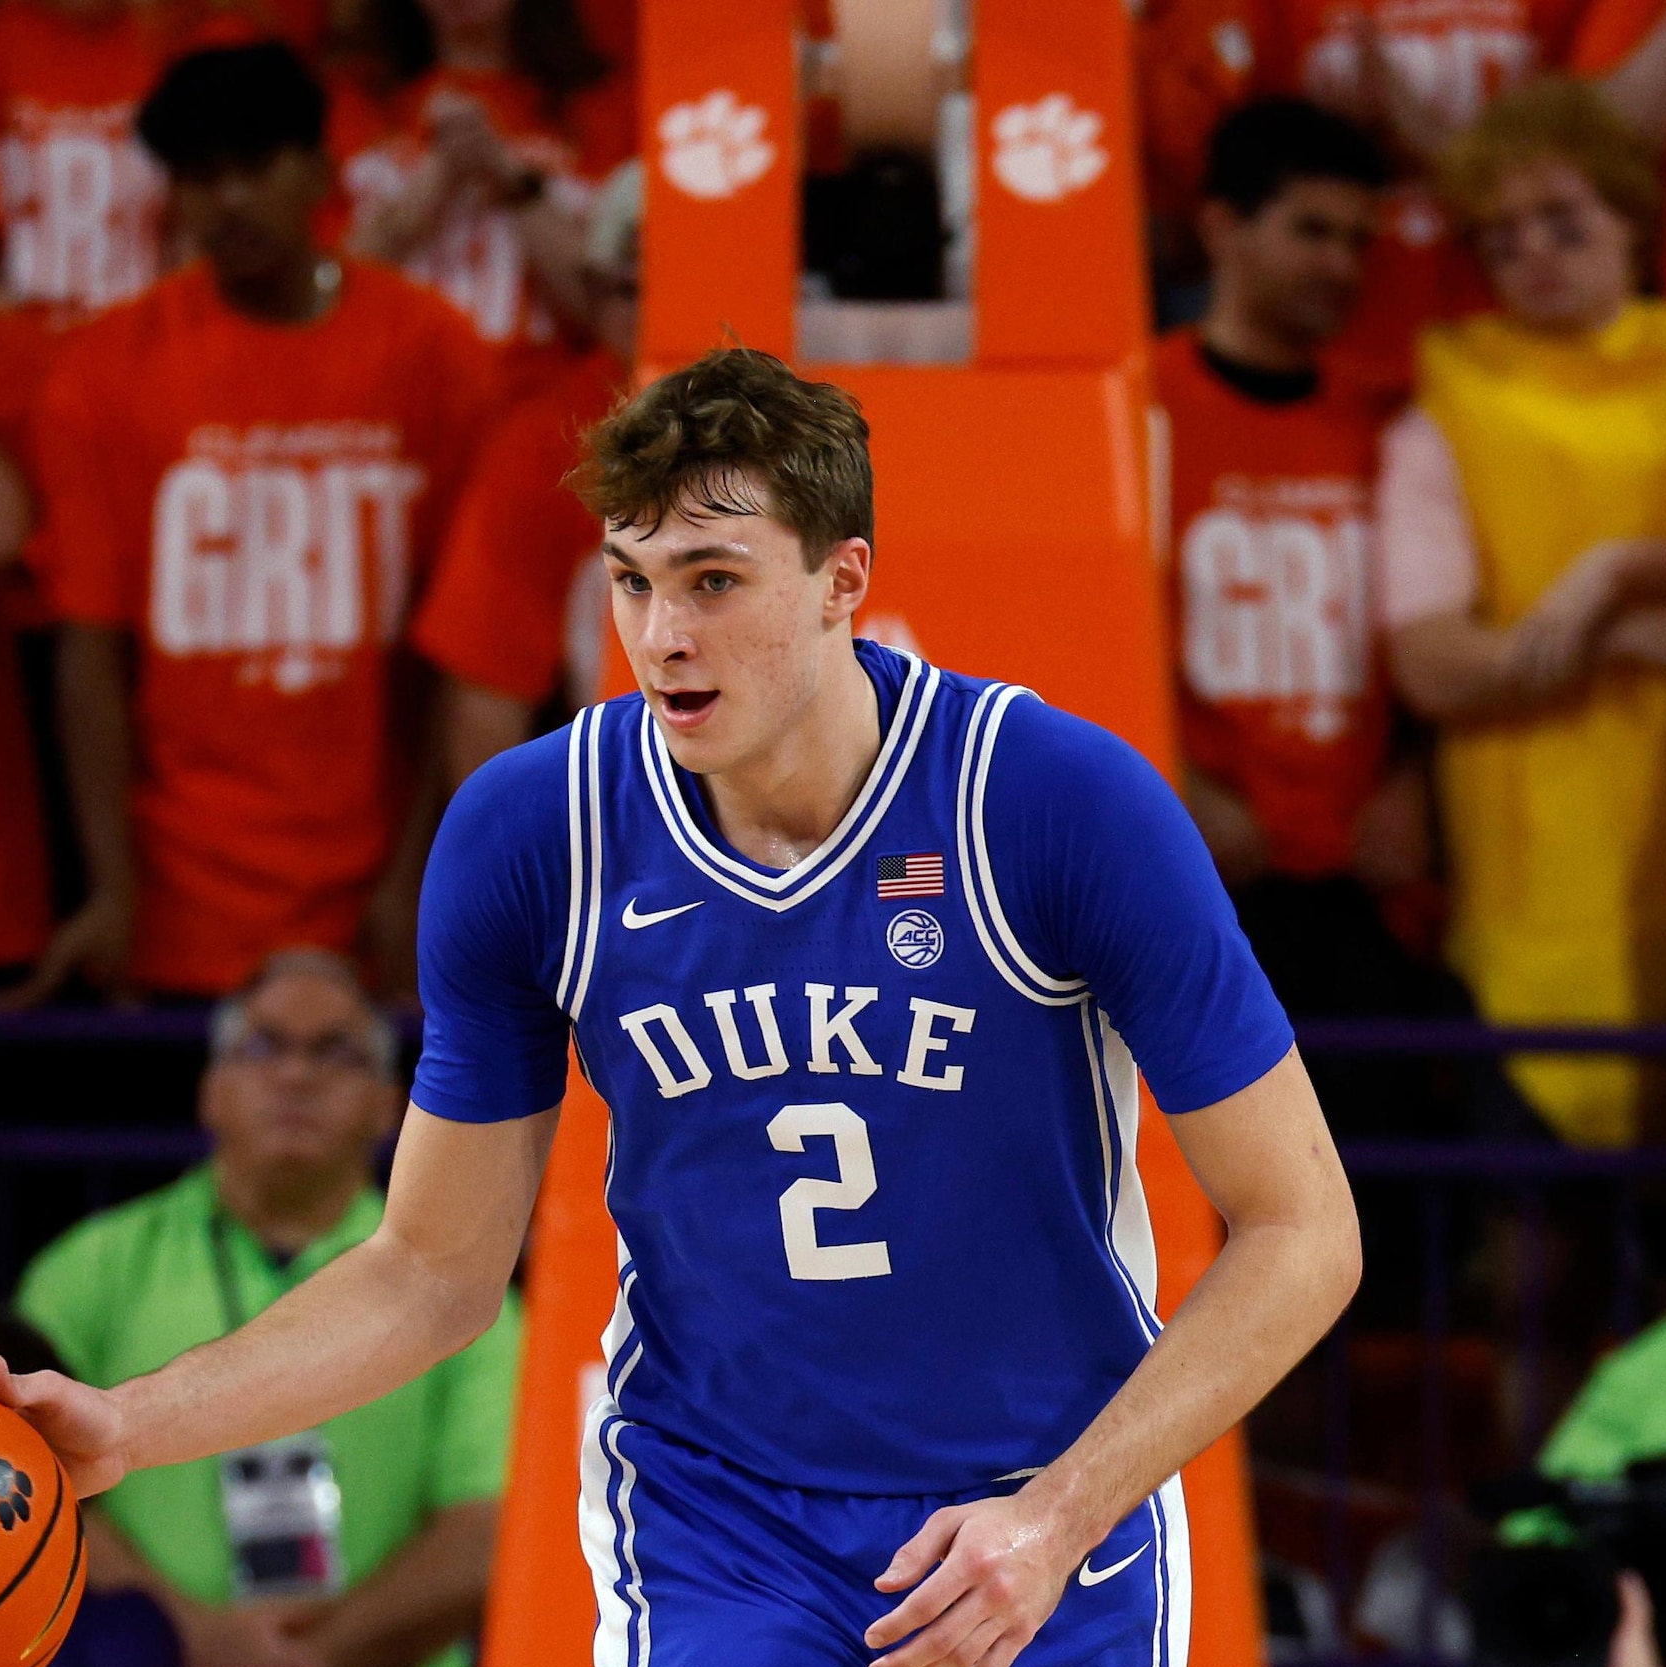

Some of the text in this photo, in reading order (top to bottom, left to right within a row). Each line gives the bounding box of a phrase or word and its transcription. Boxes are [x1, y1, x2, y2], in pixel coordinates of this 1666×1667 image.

[150, 460, 426, 655] GRIT
[619, 983, 976, 1099] DUKE
[766, 1102, 892, 1281] 2
